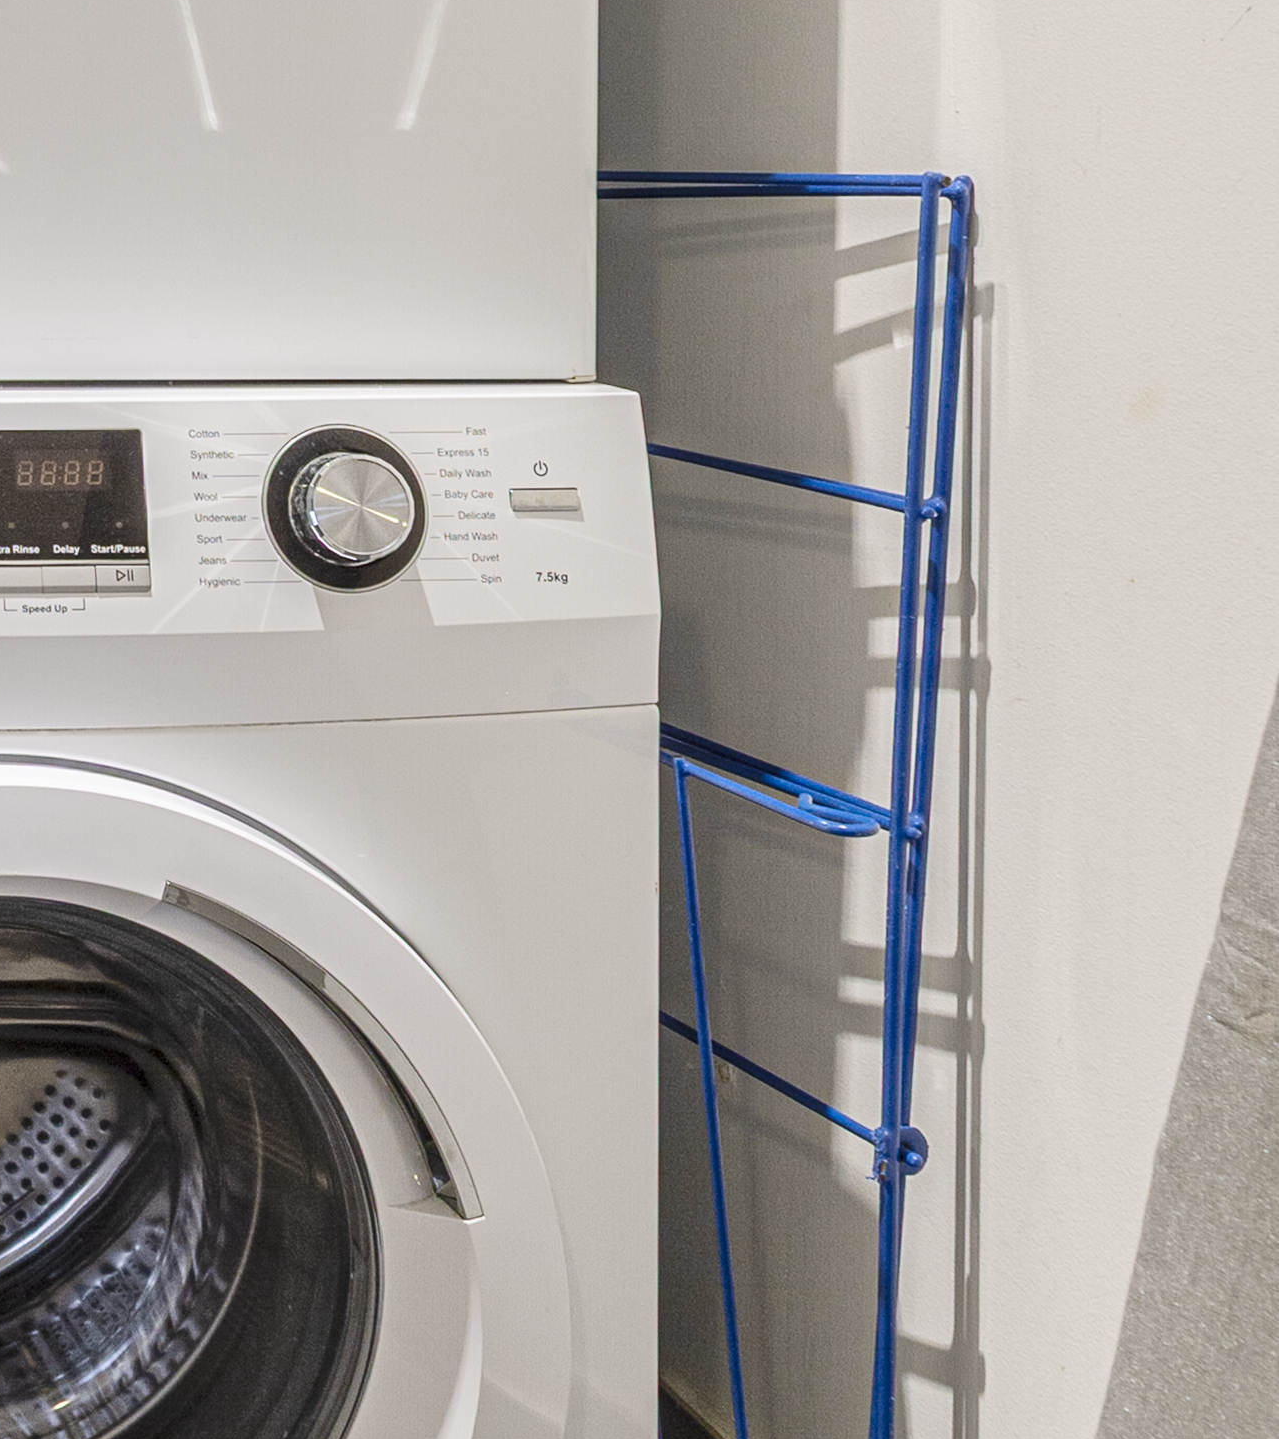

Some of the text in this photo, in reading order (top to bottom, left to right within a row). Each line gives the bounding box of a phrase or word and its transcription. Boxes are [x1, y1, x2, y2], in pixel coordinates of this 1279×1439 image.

[188, 429, 220, 439] Cotton
[465, 427, 487, 436] Fast
[190, 450, 234, 461] Synthetic
[437, 448, 489, 459] Express 15
[191, 471, 208, 480] Mix
[440, 469, 492, 480] Daily Wash
[194, 492, 218, 501] Wool
[444, 490, 493, 500] Baby Care
[194, 513, 247, 522] Underwear
[458, 511, 496, 520] Delicate
[196, 534, 223, 546] Sport
[444, 532, 498, 541] Hand Wash
[12, 545, 40, 554] Rinse
[52, 544, 80, 556] Delay
[91, 544, 146, 554] Start/Pause
[198, 556, 228, 565] Jeans
[472, 553, 500, 562] Duvet
[199, 577, 241, 588] Hygienic
[480, 574, 502, 584] Spin
[536, 572, 568, 584] 7.5kg
[22, 604, 68, 614] Speed Up
